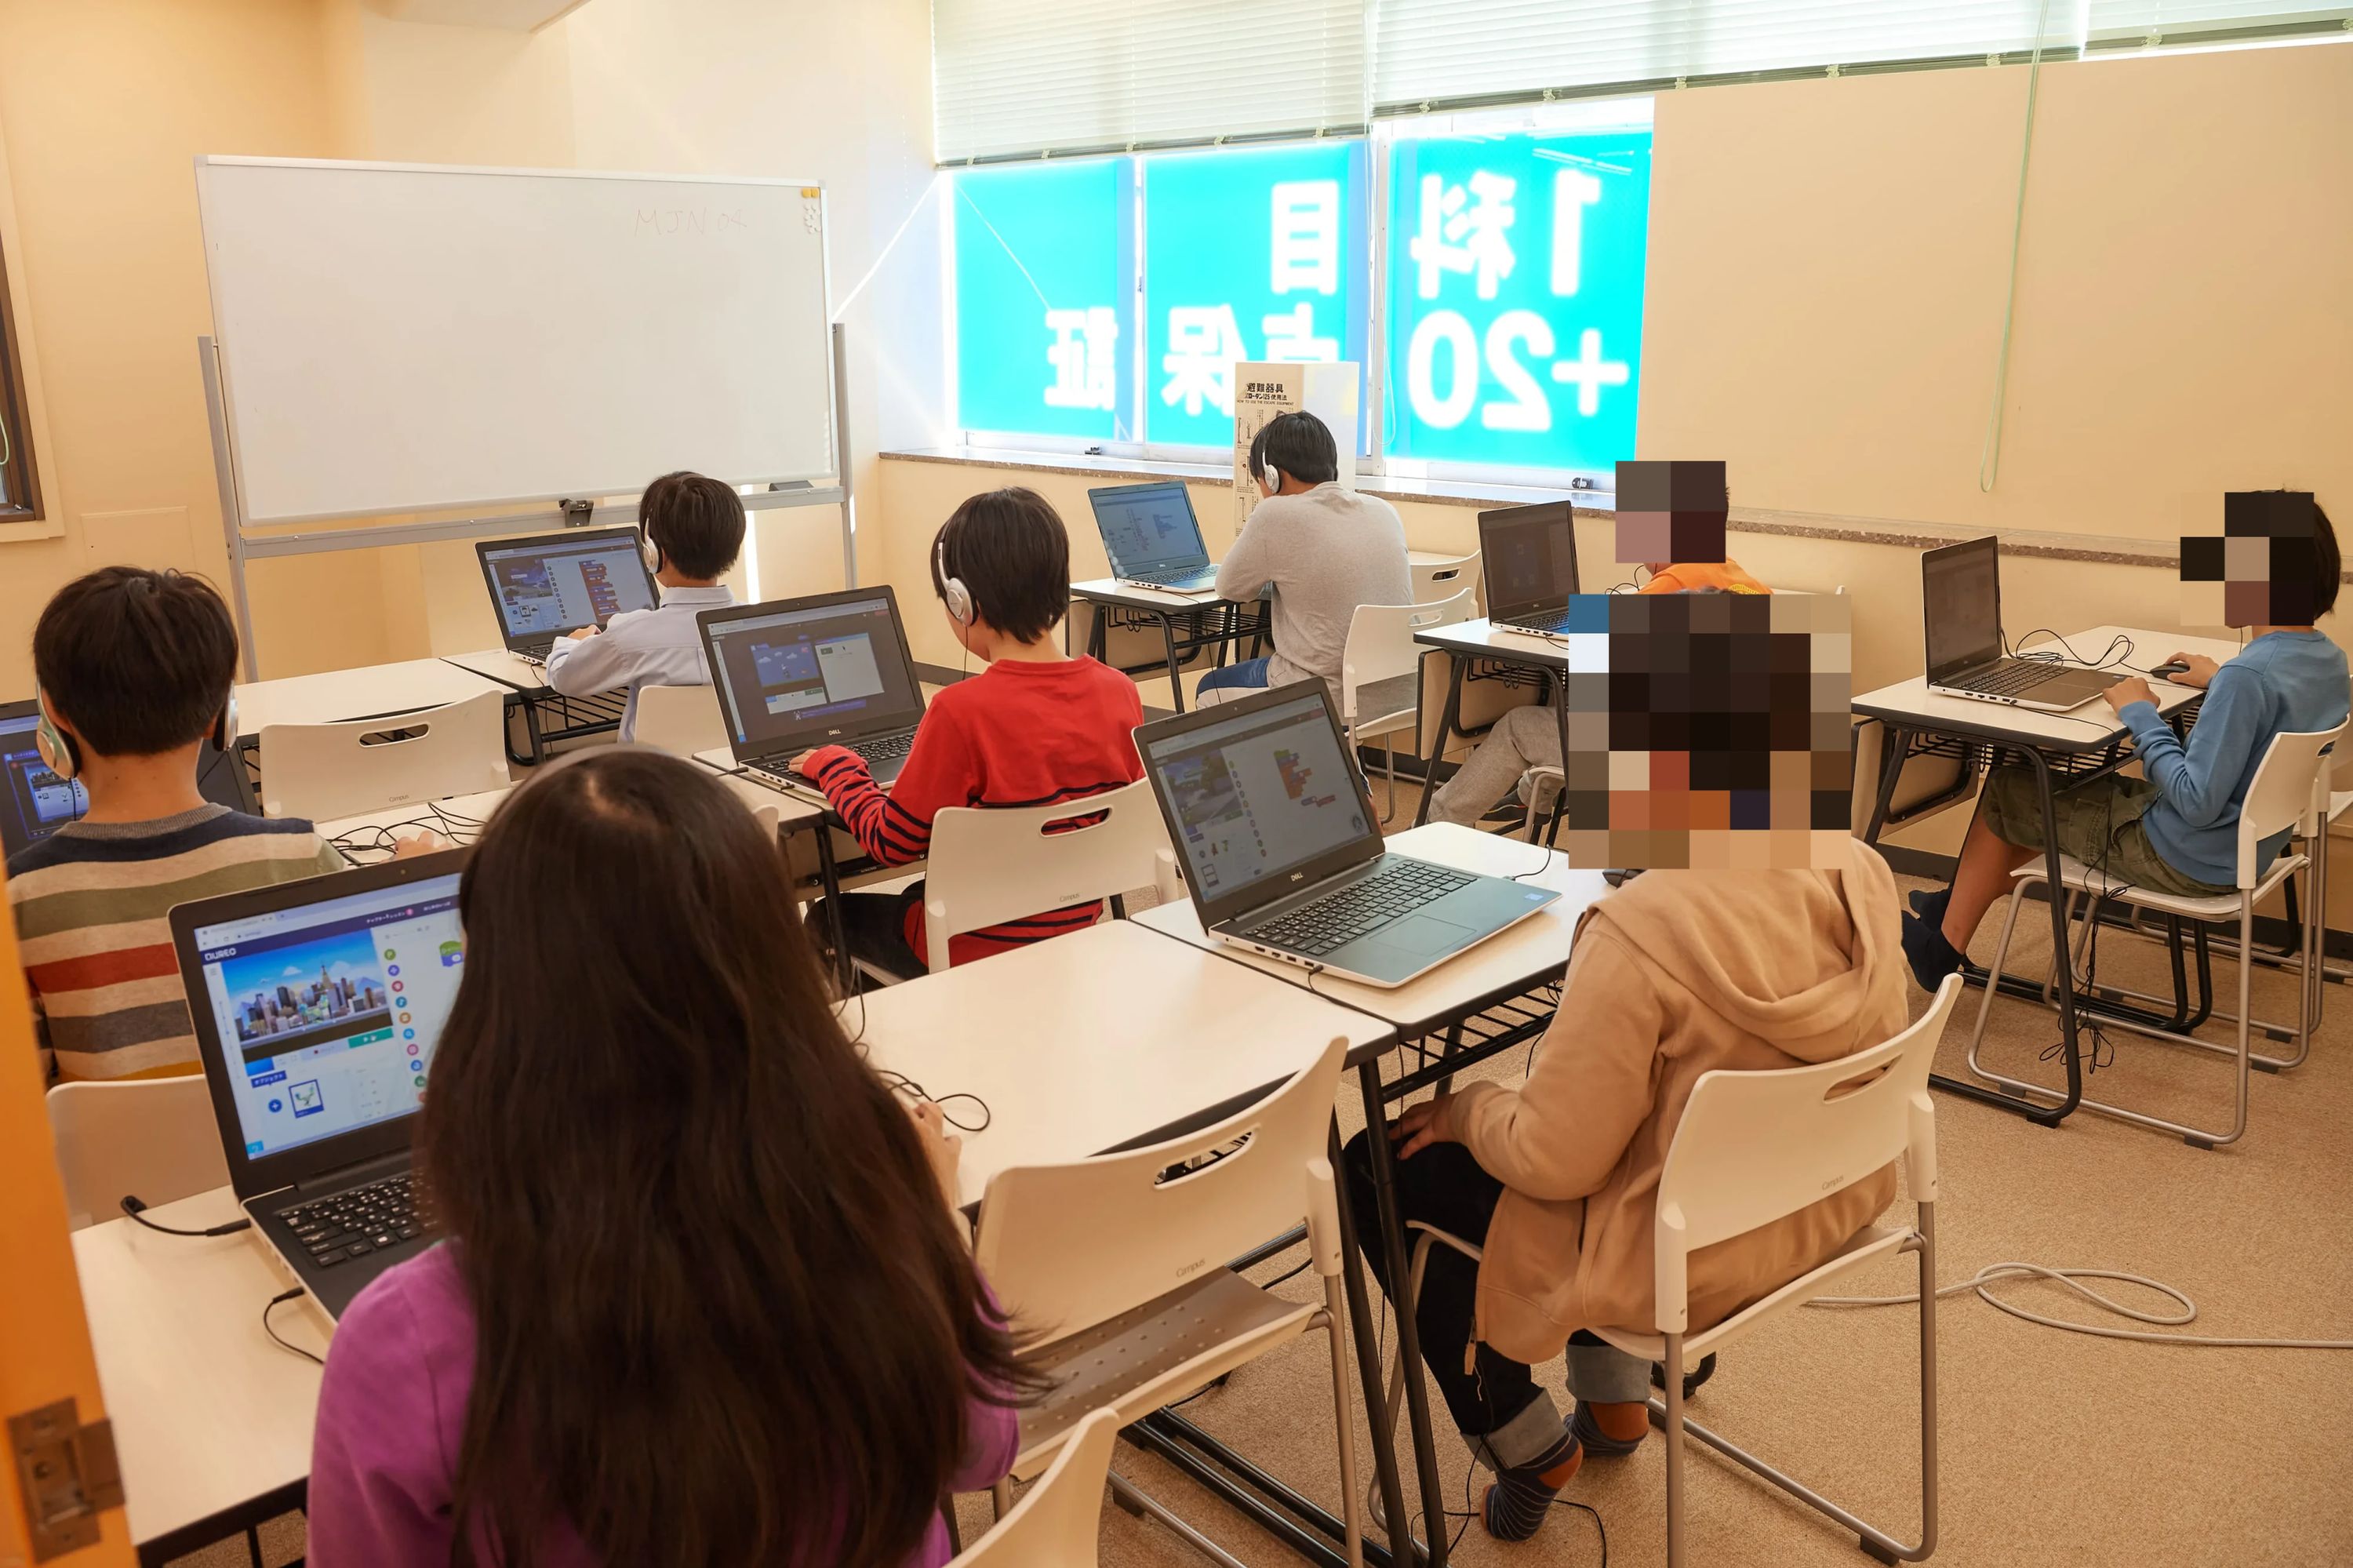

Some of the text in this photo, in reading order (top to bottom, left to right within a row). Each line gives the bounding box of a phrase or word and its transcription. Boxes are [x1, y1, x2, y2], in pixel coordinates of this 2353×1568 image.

[1246, 382, 1283, 393] 避難器具
[1290, 872, 1304, 882] DELL
[1059, 893, 1080, 902] Campus
[1176, 1258, 1206, 1278] Campus
